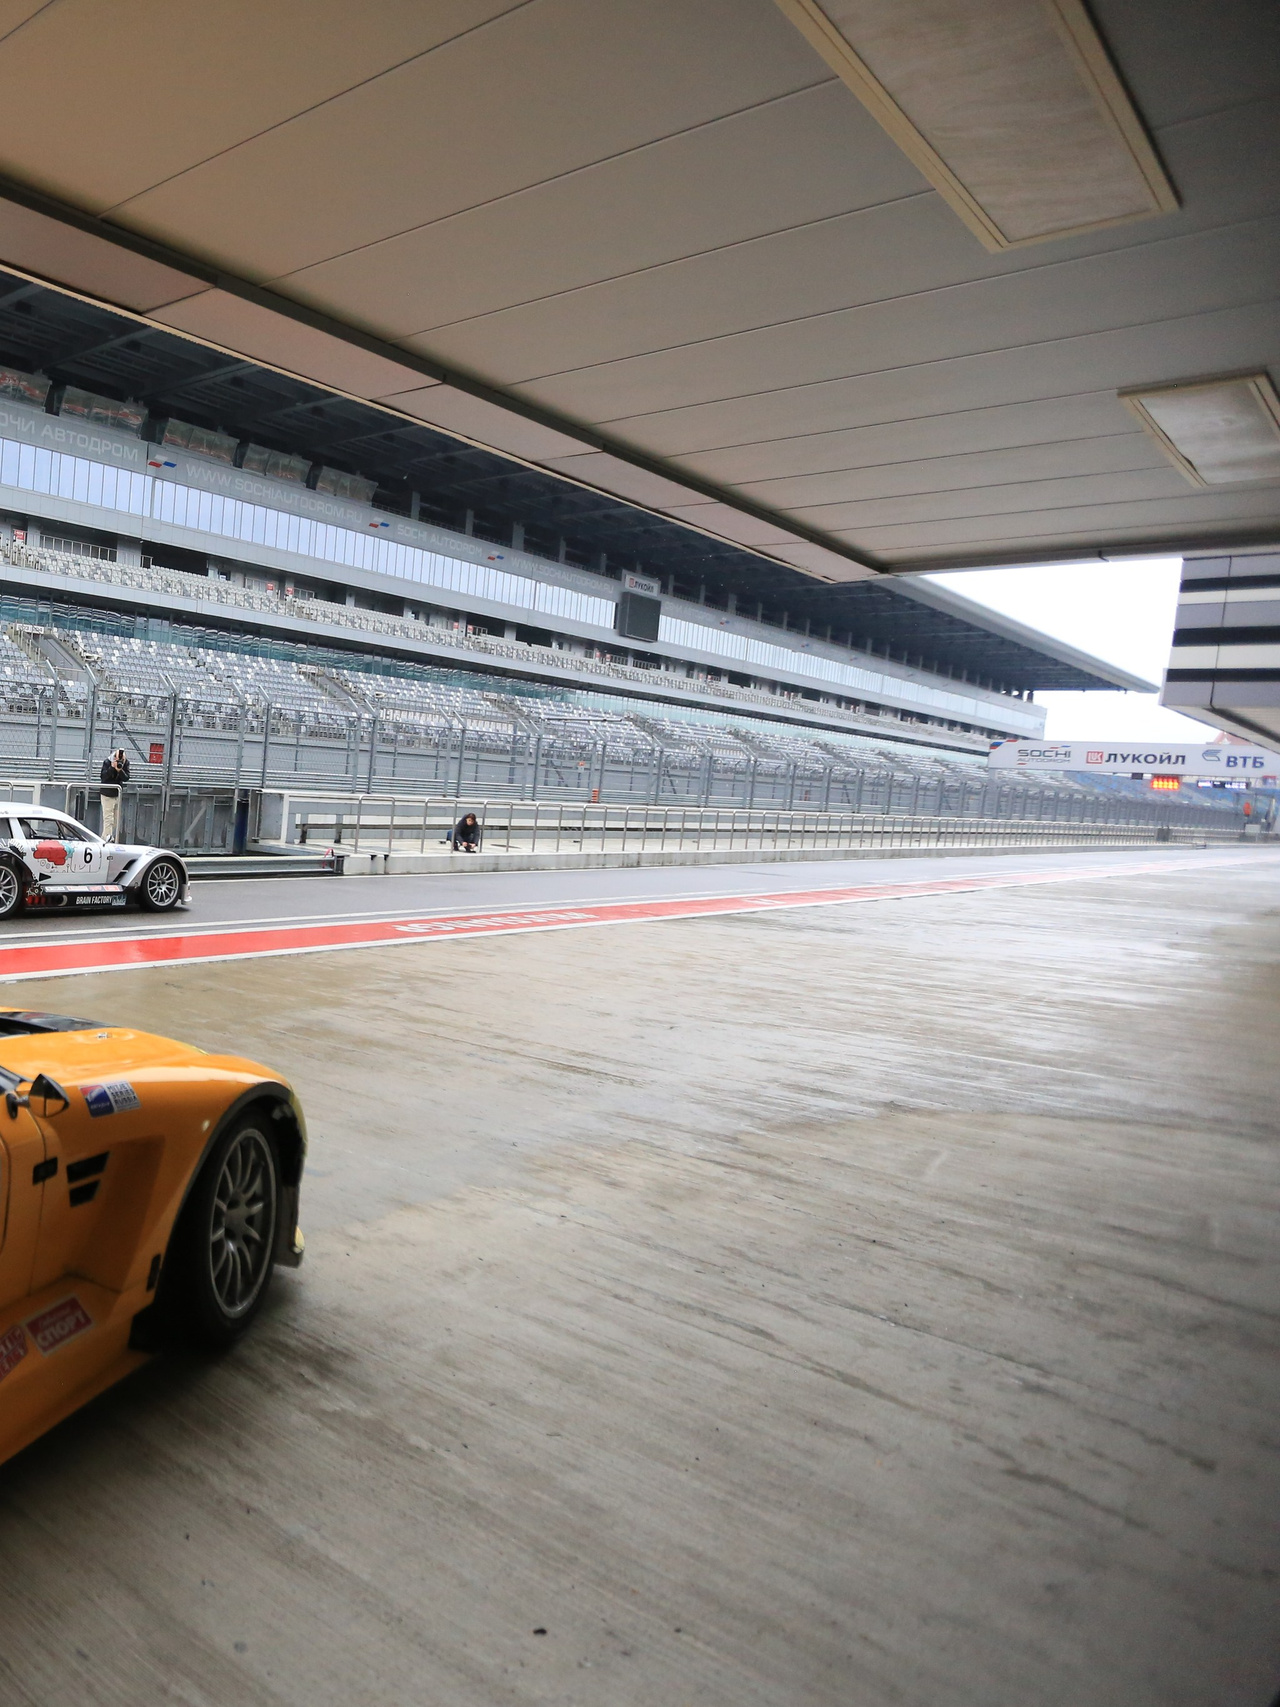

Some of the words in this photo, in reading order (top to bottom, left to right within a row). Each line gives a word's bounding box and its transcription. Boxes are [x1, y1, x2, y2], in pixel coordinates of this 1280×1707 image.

[41, 424, 139, 463] АВТОДРОМ
[186, 462, 363, 524] WWW.SOCHIAUTODROM.RU
[397, 523, 428, 543] SOCHI
[1018, 749, 1071, 758] SOCHI
[1105, 750, 1186, 766] ЛУКОЙЛ
[1225, 755, 1265, 769] ВТБ
[83, 846, 93, 864] 6
[76, 896, 91, 905] BRAIN
[91, 895, 112, 904] FACTORY
[36, 1311, 87, 1347] СПОРТ
